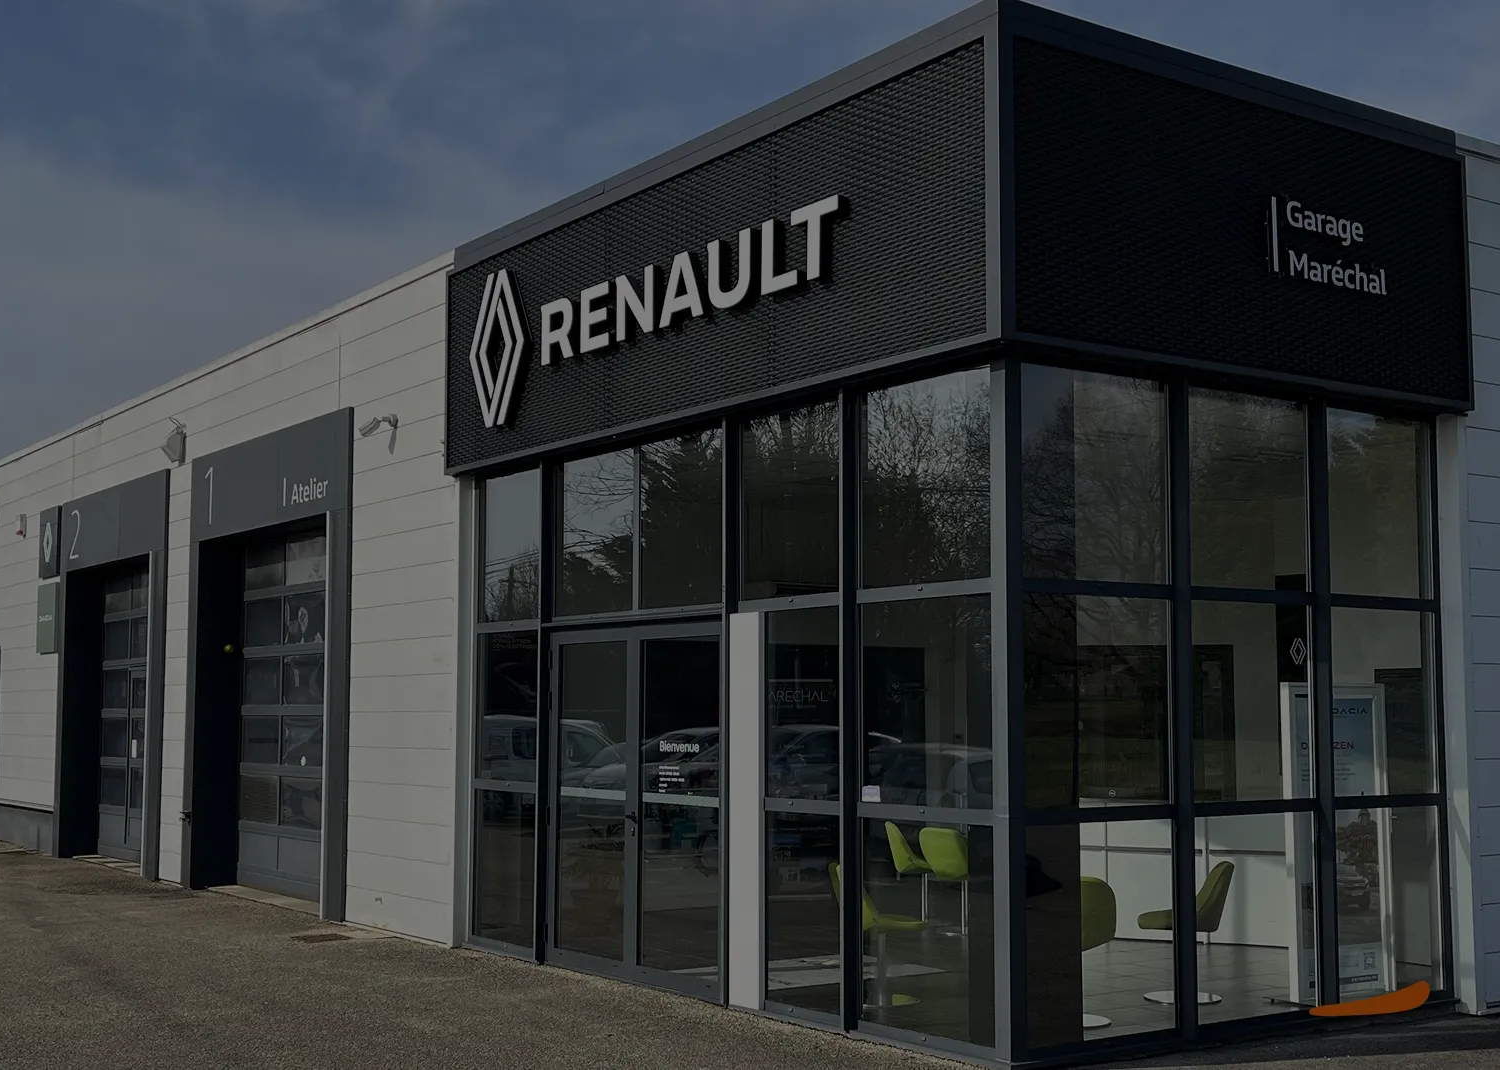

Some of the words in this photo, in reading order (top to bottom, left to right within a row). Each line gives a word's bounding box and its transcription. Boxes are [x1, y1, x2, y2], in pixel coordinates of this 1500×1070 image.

[1286, 200, 1363, 246] Garage
[541, 194, 839, 366] RENAULT
[1288, 249, 1387, 295] Maréchal
[204, 466, 214, 525] 1
[290, 476, 328, 505] Atelier
[69, 509, 82, 560] 2
[768, 689, 829, 703] ARECHAL
[659, 740, 700, 753] Bienvenue
